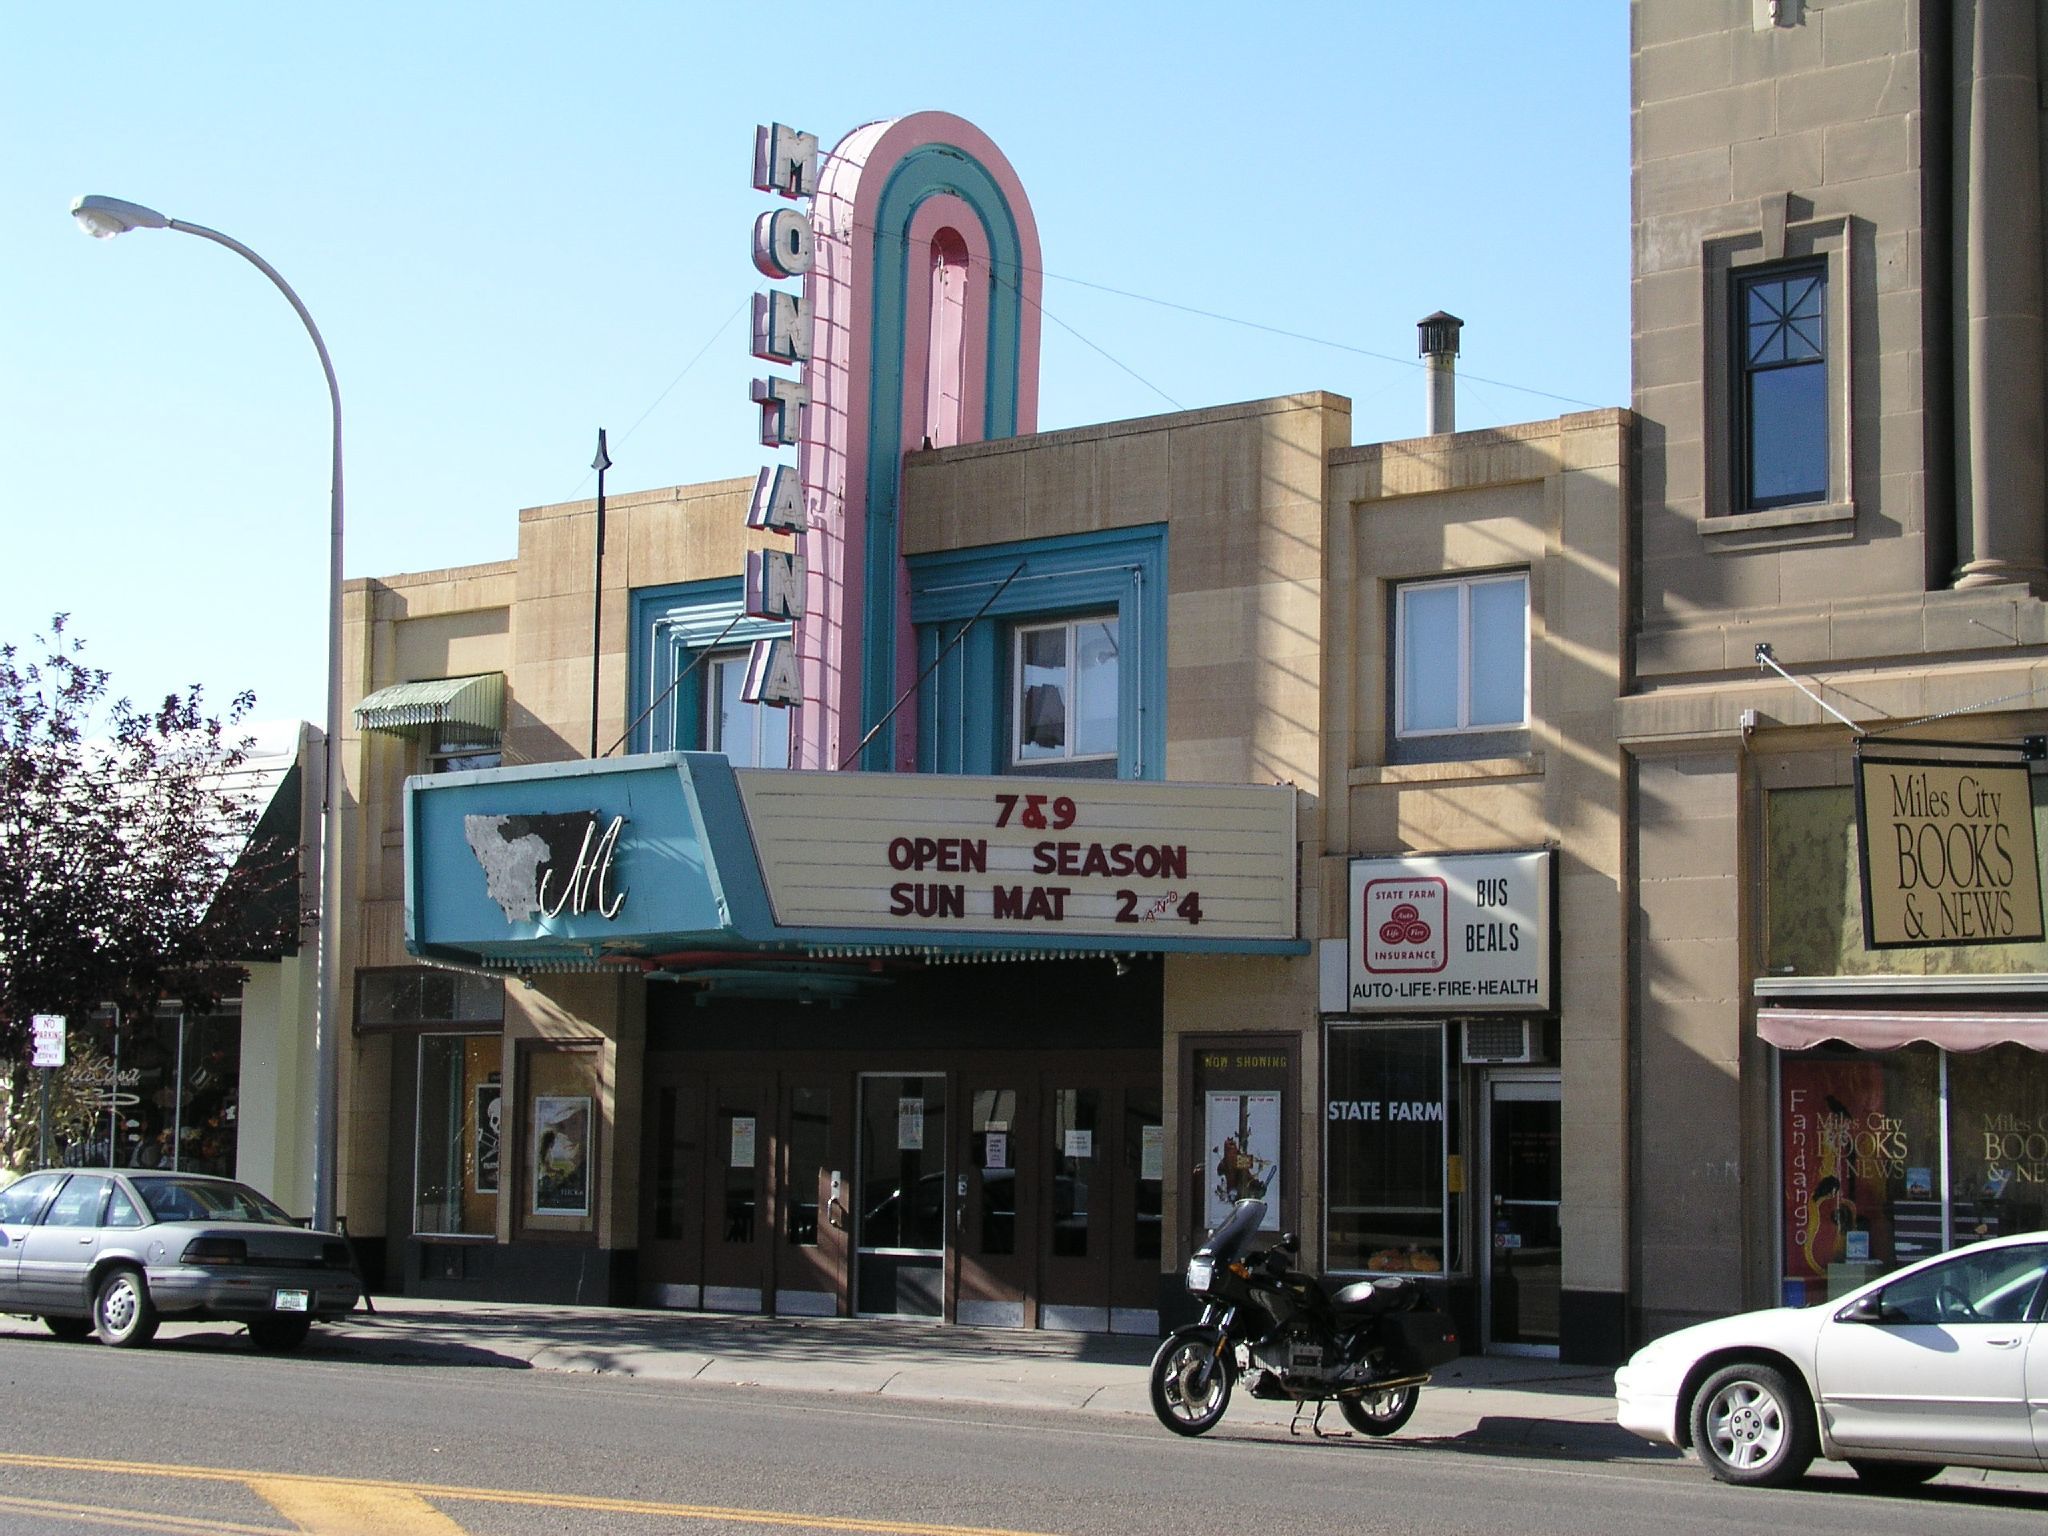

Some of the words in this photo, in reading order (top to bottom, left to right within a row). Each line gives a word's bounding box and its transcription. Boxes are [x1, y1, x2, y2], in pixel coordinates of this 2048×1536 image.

[740, 120, 819, 707] MONTANA
[1890, 772, 1950, 817] Miles
[1958, 775, 2001, 823] City
[888, 837, 987, 873] OPEN
[1033, 841, 1187, 879] SEASON
[1893, 822, 2014, 889] BOOKS
[890, 883, 965, 918] SUN
[993, 885, 1071, 921] MAT
[1116, 889, 1139, 923] 2
[1144, 890, 1178, 923] AND
[1177, 891, 1203, 925] 4
[1375, 889, 1404, 900] STATE
[1408, 889, 1436, 899] FARM
[1476, 878, 1508, 908] BUS
[1396, 912, 1414, 920] Auto
[1903, 892, 1930, 939] &
[1937, 890, 2014, 939] NEWS
[1466, 922, 1519, 952] BEALS
[1375, 950, 1436, 960] INSURANCE
[1204, 1056, 1228, 1068] NOW
[1236, 1056, 1287, 1068] SHOWING
[1328, 1100, 1381, 1120] STATE
[1388, 1101, 1444, 1121] FARM
[1866, 1112, 1904, 1134] City
[1984, 1113, 2032, 1131] Miles
[1790, 1089, 1808, 1246] Fandango
[1846, 1159, 1905, 1179] NEWS
